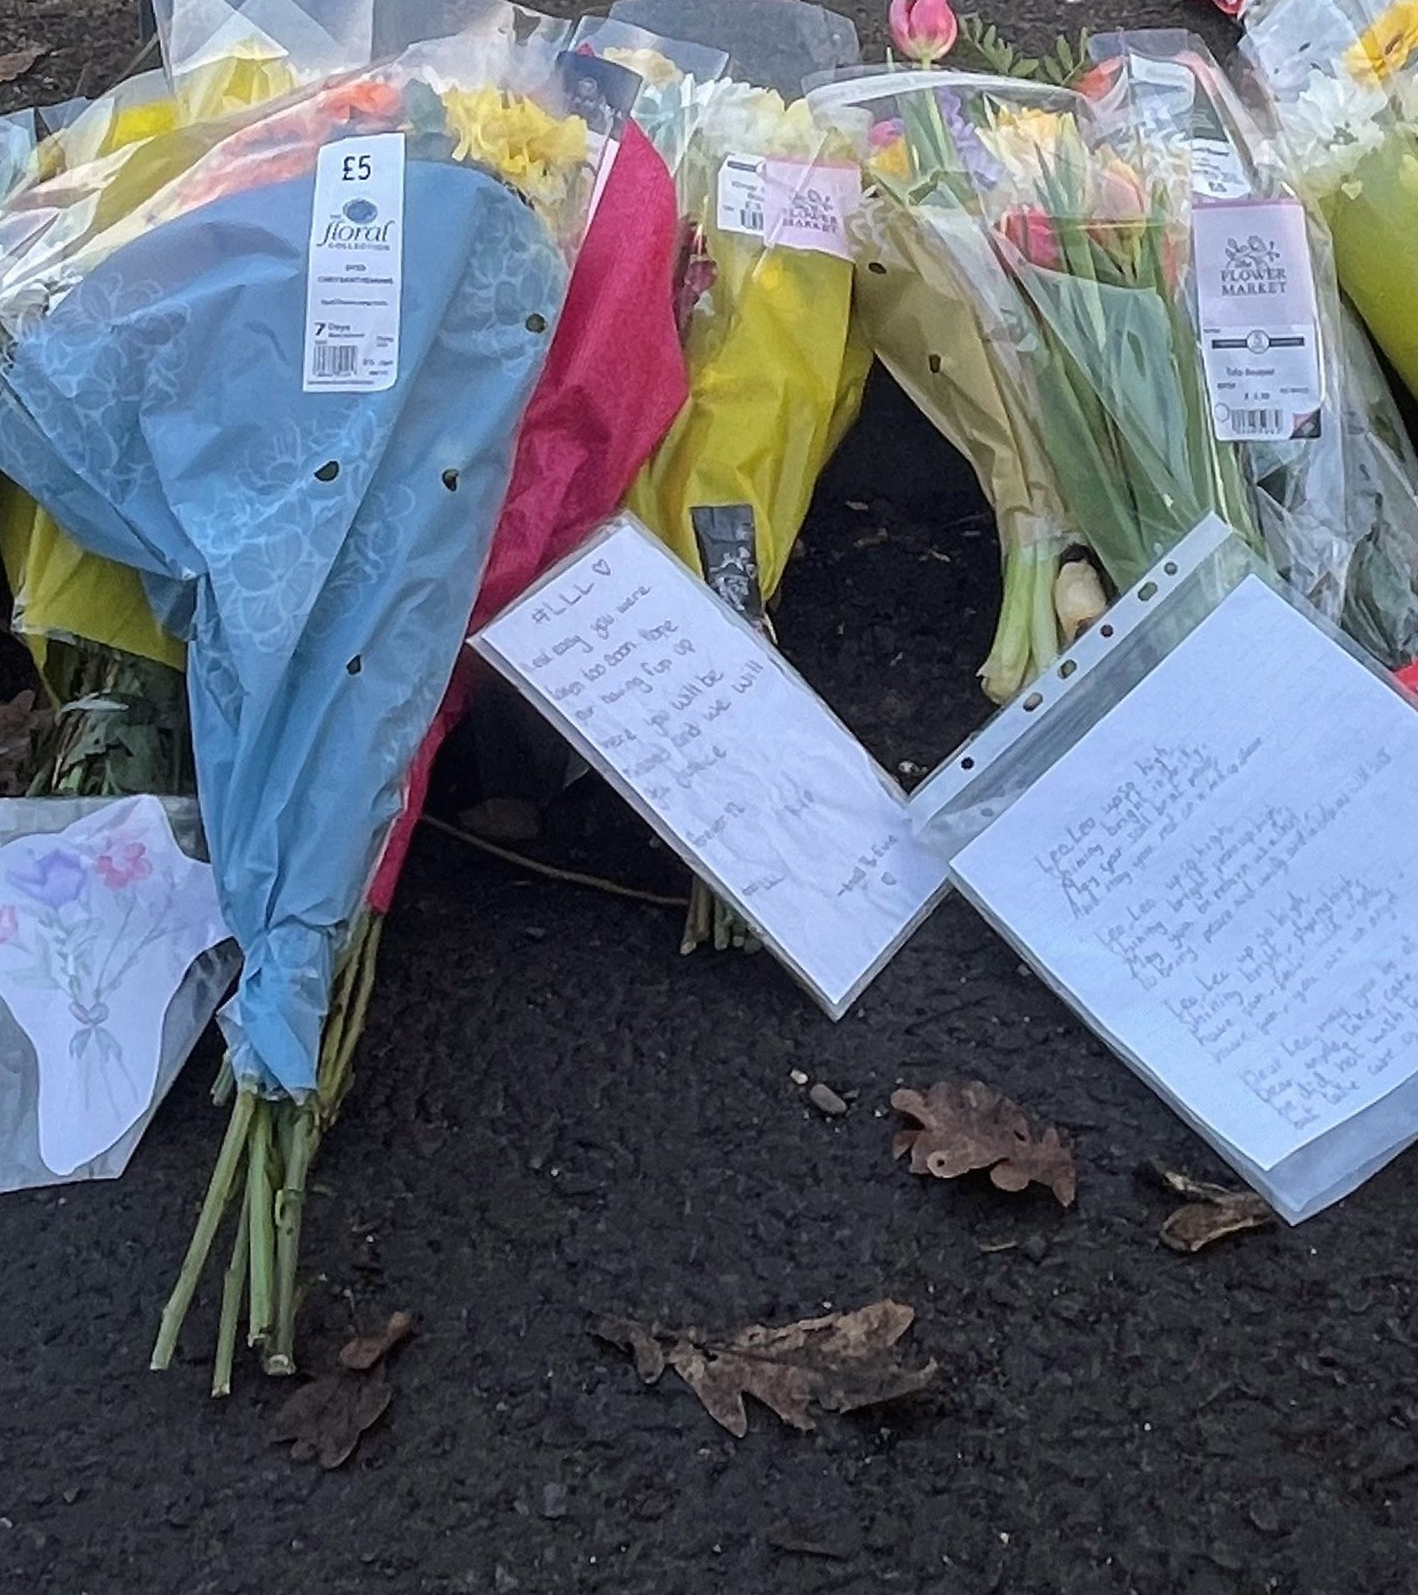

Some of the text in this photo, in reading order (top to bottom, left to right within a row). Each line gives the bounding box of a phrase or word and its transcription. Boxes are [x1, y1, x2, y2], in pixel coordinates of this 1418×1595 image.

[341, 155, 372, 181] £5
[316, 220, 395, 248] floral
[1220, 268, 1287, 282] FLOWER
[1221, 281, 1287, 296] MARKET
[589, 584, 653, 641] you were
[673, 637, 697, 657] up
[580, 640, 638, 684] too soon
[669, 668, 726, 712] will be
[730, 658, 765, 695] will
